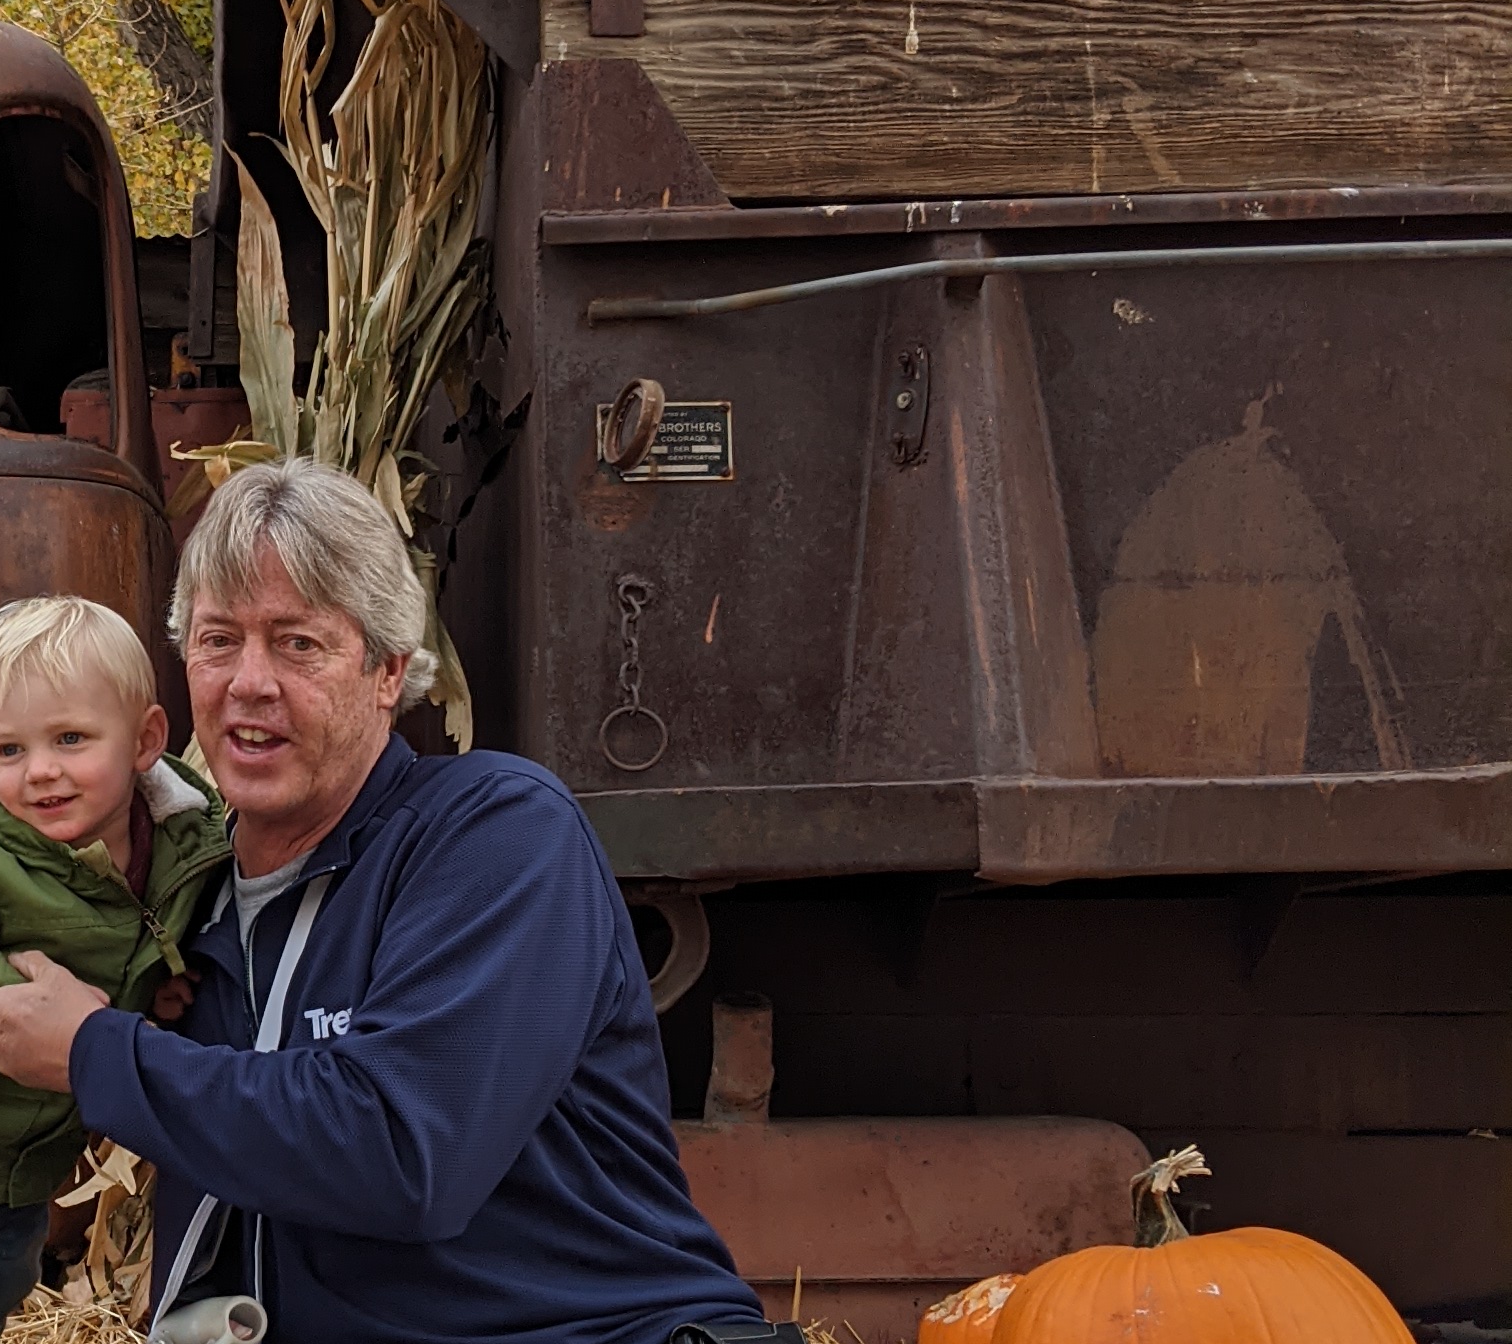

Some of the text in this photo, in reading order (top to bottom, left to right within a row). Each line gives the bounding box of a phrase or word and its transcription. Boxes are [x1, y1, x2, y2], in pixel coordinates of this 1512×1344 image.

[658, 421, 722, 433] BROTHERS
[660, 435, 708, 443] COLORADO
[304, 1007, 353, 1040] Tre
